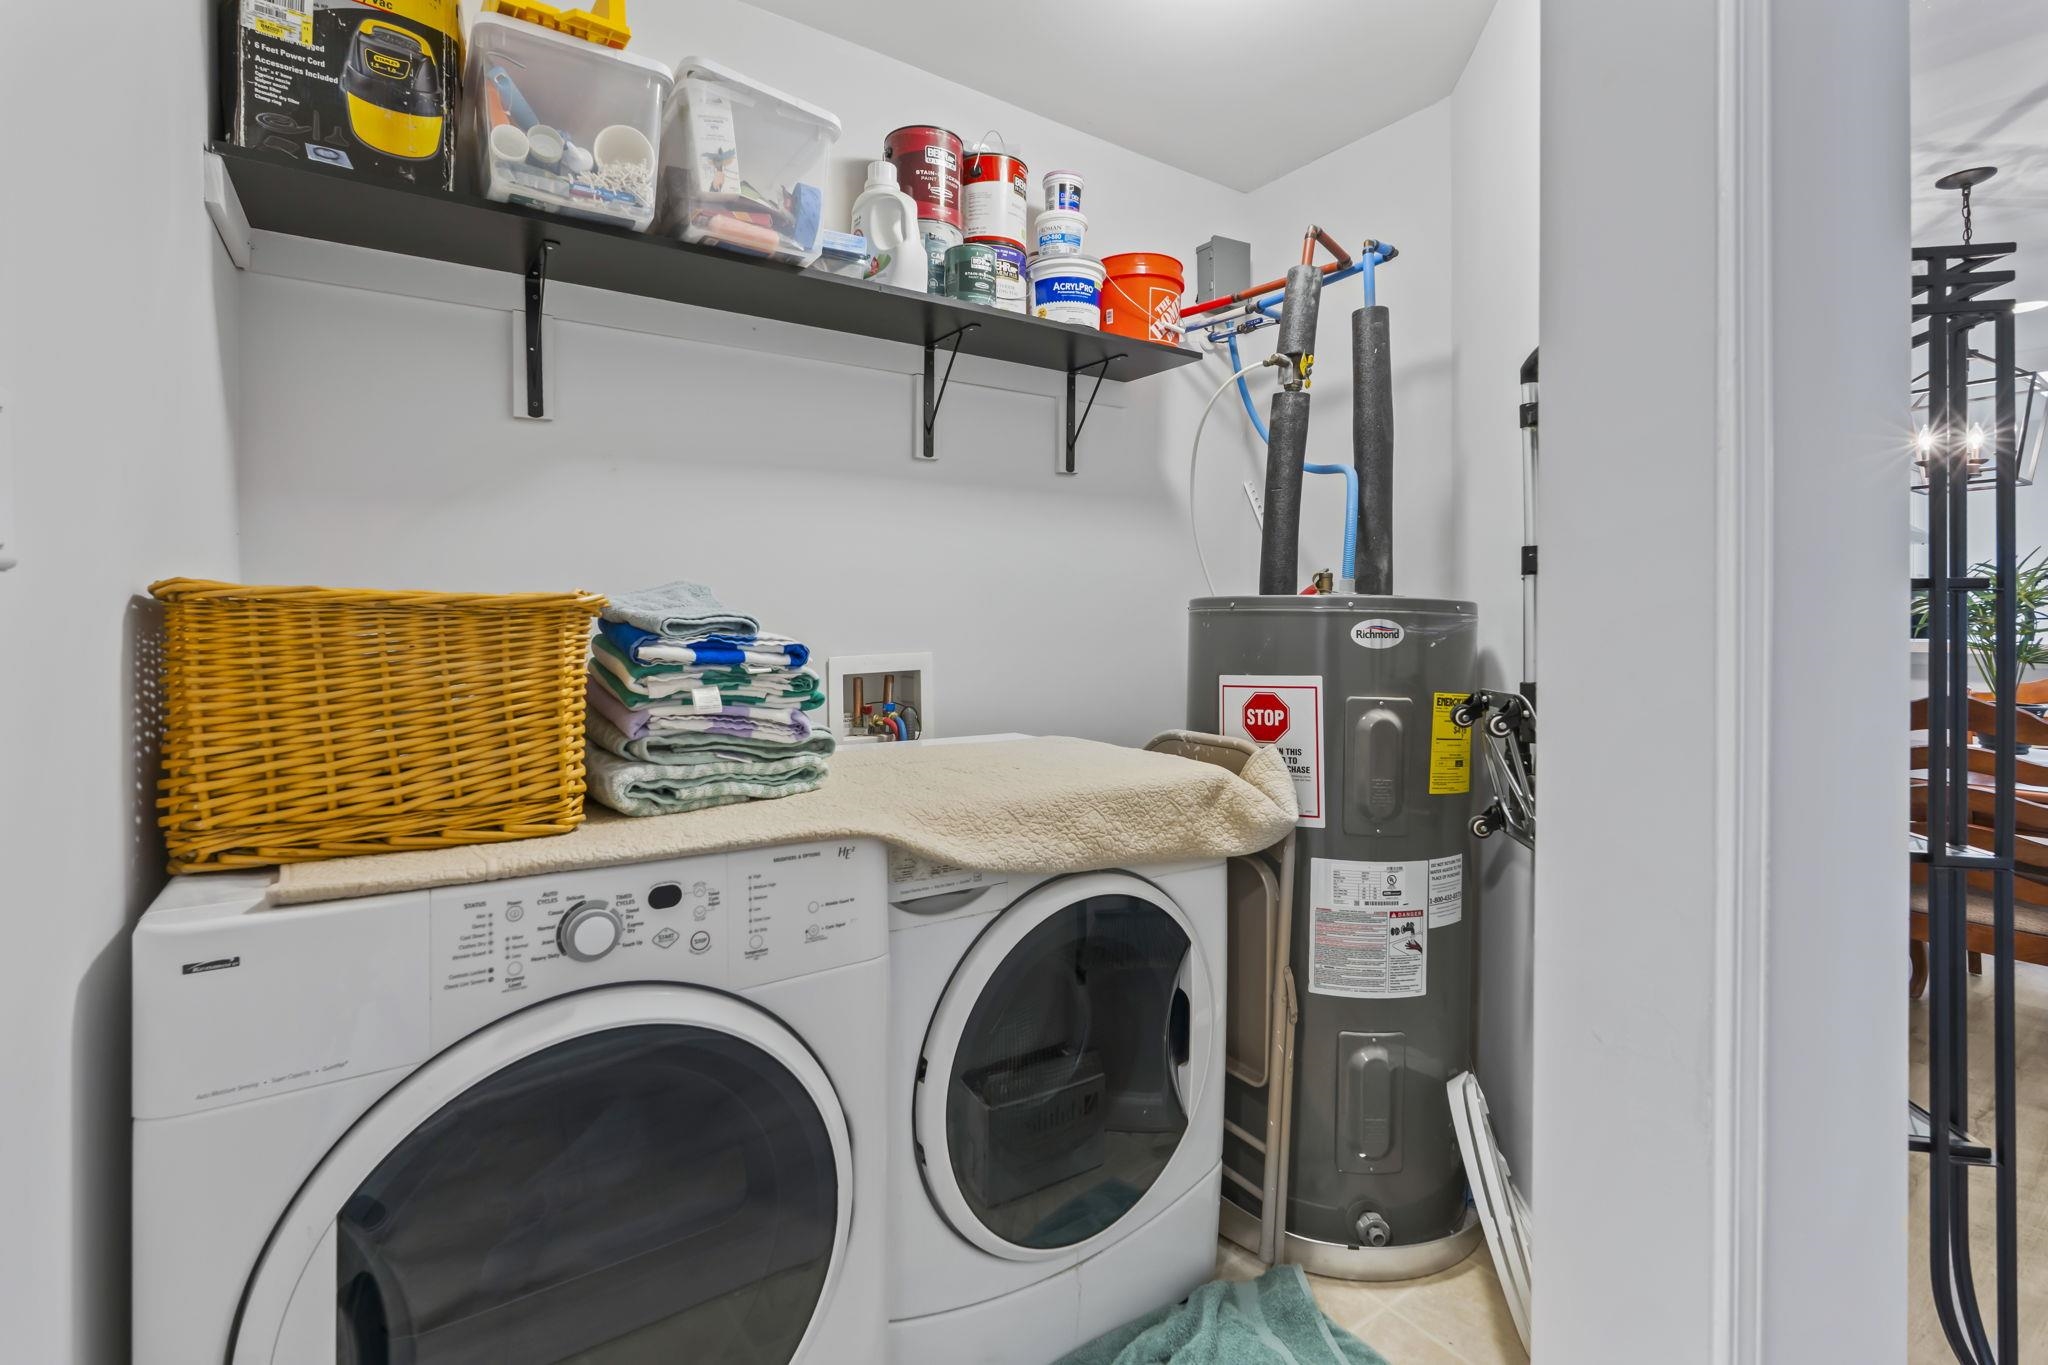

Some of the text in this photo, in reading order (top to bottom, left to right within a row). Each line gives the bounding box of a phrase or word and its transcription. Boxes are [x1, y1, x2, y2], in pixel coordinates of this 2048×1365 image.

[254, 41, 326, 68] 6 Feet Power Cord
[254, 54, 339, 84] Accessories Included
[1154, 295, 1172, 315] THE
[1356, 629, 1400, 639] Richmond
[1246, 709, 1285, 726] STOP
[1287, 748, 1302, 756] THIS
